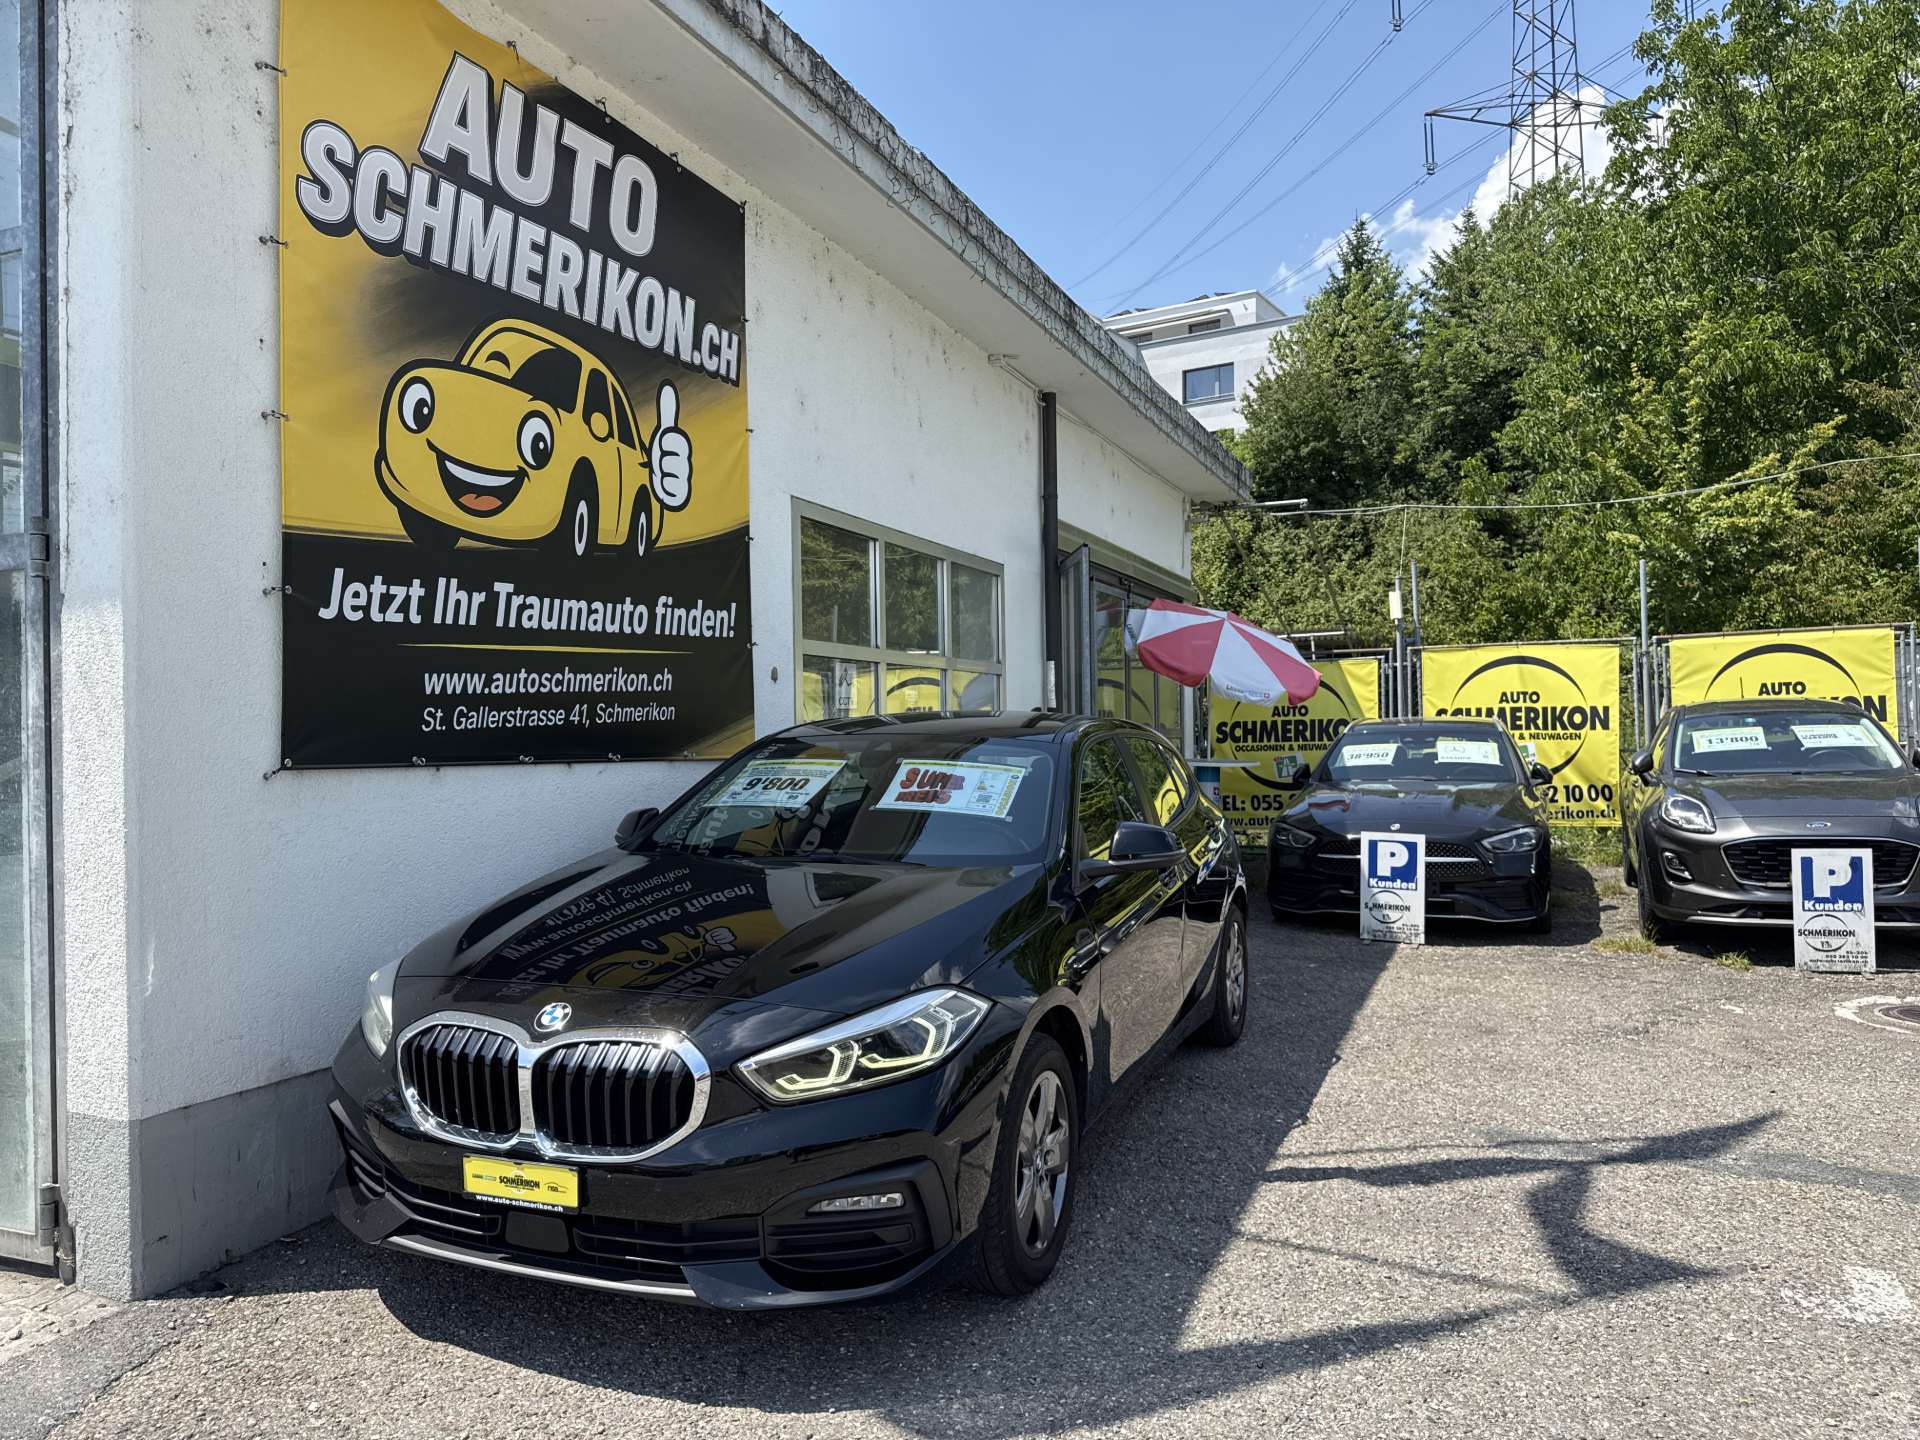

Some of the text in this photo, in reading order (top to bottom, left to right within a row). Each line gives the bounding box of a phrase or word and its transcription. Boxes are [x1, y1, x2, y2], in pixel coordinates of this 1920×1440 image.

[420, 52, 658, 257] AUTO
[297, 122, 740, 382] SCHMERIKON.CH
[319, 568, 737, 638] Jetzt Ihr Traumauto finden!
[423, 666, 673, 696] www.autoschmerikon.ch
[1758, 681, 1806, 697] AUTO
[1499, 691, 1541, 704] AUTO
[421, 702, 675, 732] St. Gallerstrasse 41, Schmerikon
[1271, 705, 1309, 718] AUTO
[1216, 718, 1358, 744] SCHMERIKO
[1518, 733, 1526, 741] &
[1528, 732, 1581, 741] NEUWAGEN
[1234, 743, 1286, 752] OCCASIONEN
[742, 777, 811, 791] 9'800
[1219, 794, 1284, 812] EL: 055
[1376, 841, 1409, 877] P
[1368, 878, 1417, 890] Kunden
[1812, 856, 1852, 898] P
[1803, 899, 1863, 912] Kunden
[1797, 928, 1856, 938] SCHMERIKON
[498, 1175, 541, 1190] SCHMERIKON
